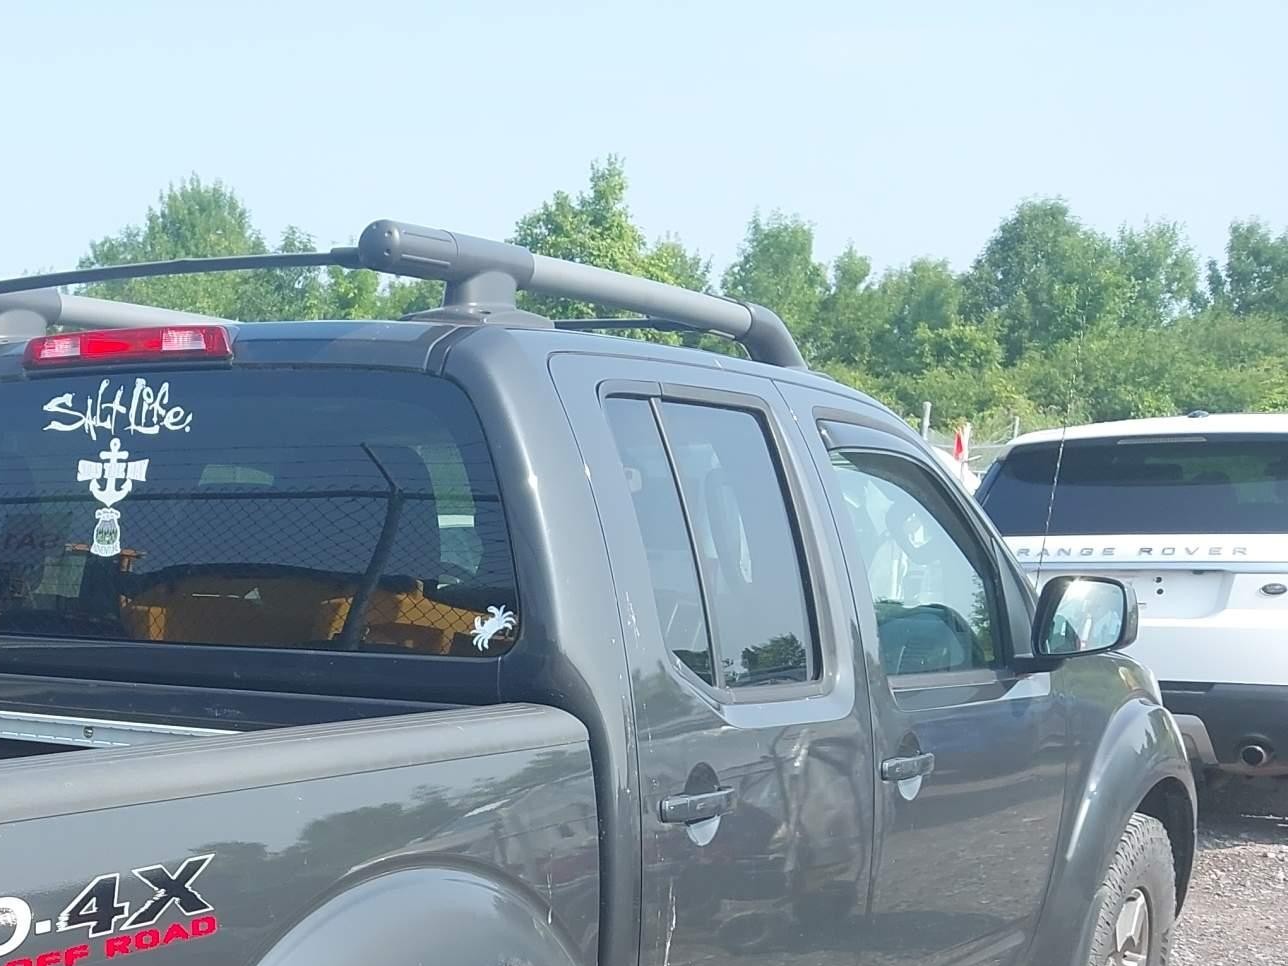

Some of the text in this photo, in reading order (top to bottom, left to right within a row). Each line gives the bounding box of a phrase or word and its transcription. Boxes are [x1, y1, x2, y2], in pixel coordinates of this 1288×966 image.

[1016, 547, 1248, 557] RANGE ROVER
[104, 916, 217, 958] ROAD
